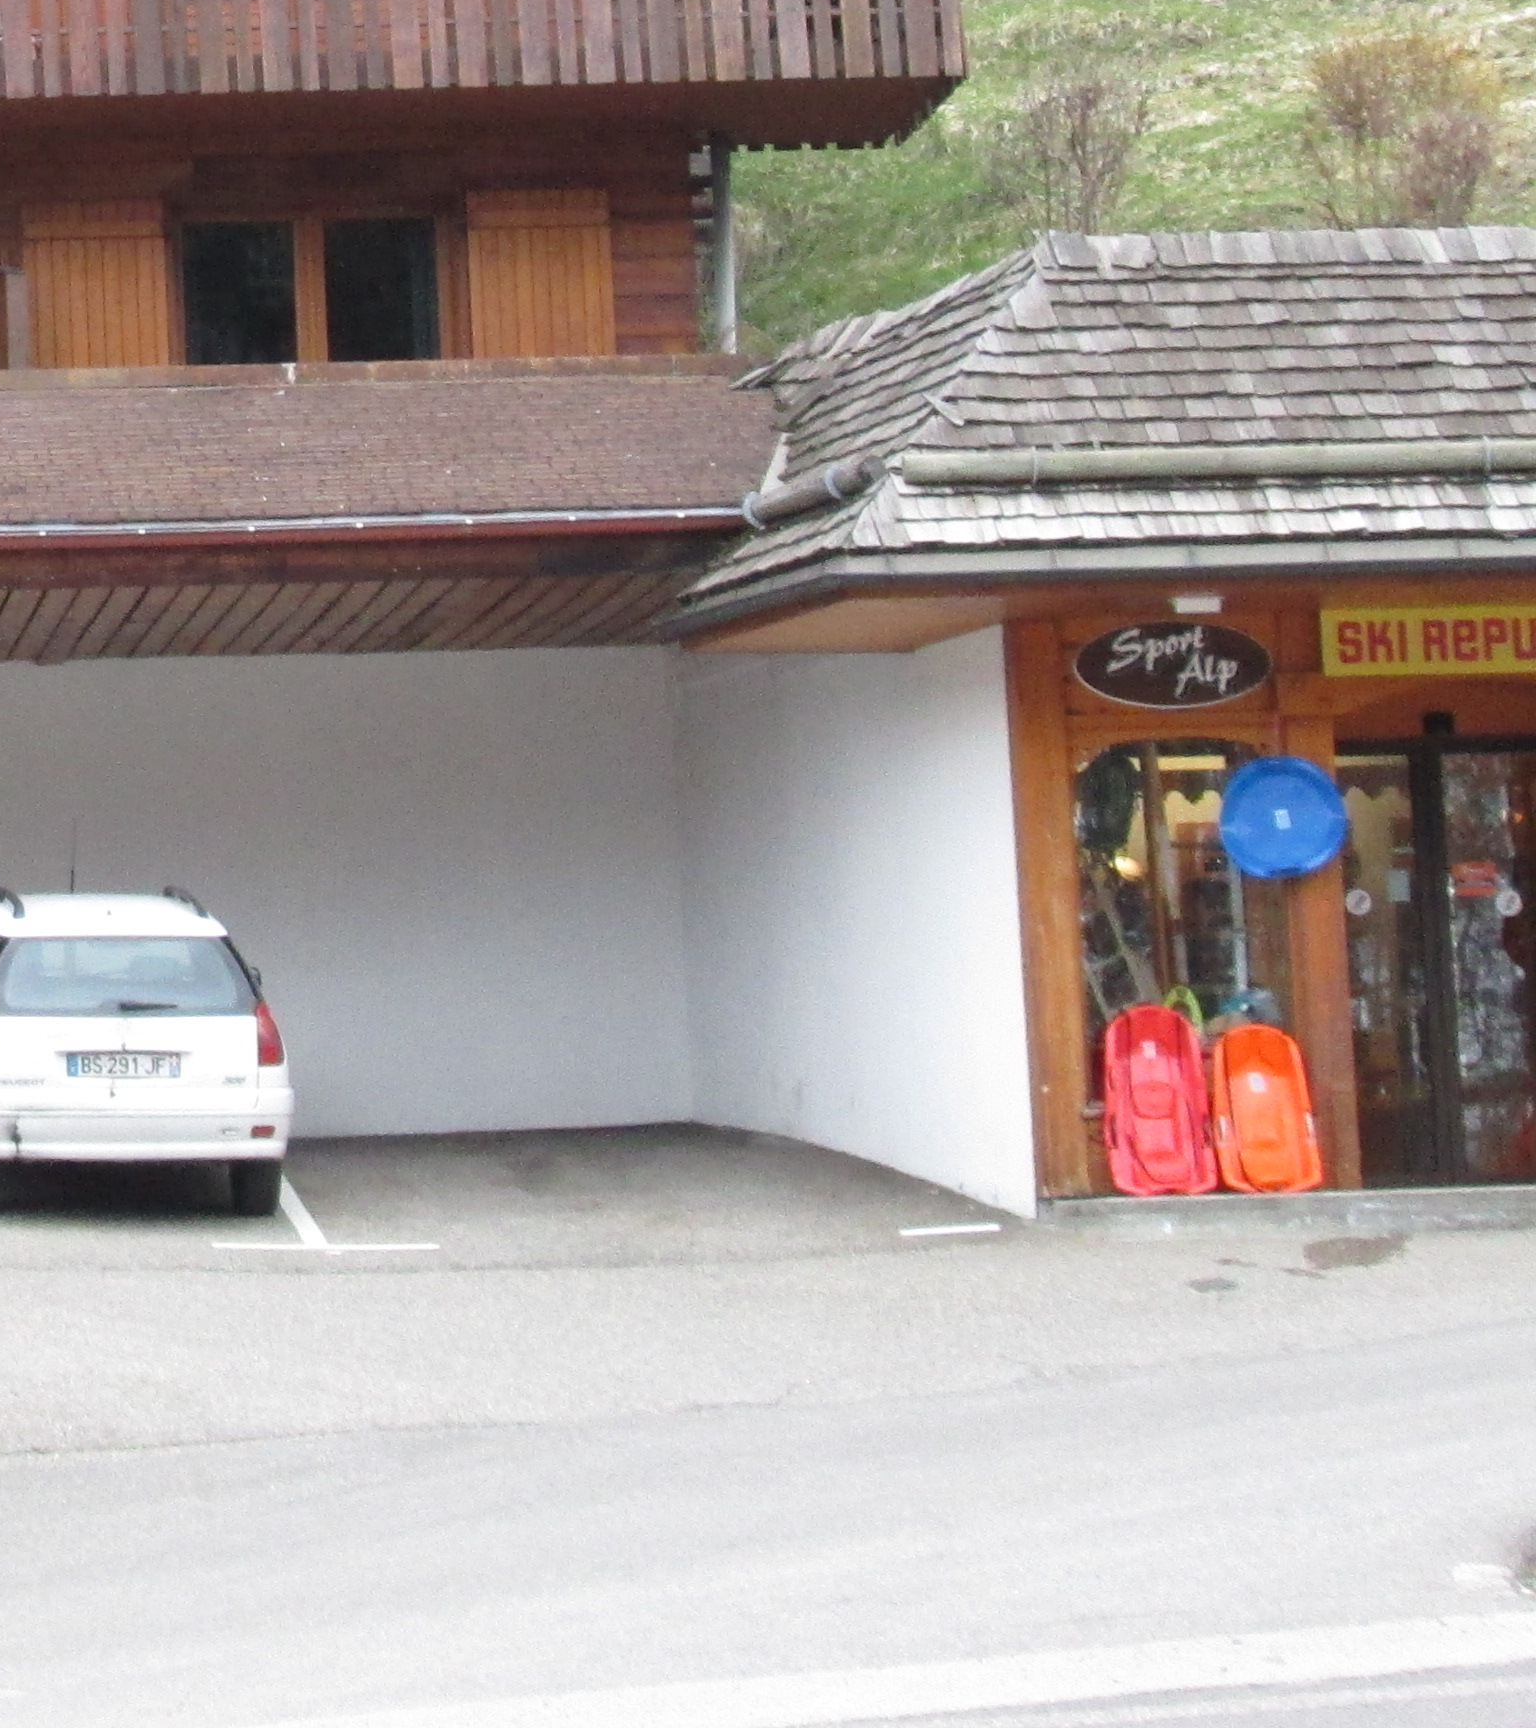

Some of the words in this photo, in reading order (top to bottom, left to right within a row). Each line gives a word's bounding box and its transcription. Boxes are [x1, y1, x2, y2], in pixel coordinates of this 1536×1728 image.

[1106, 625, 1205, 673] Sport
[1338, 620, 1407, 663] SKI
[1175, 650, 1238, 698] Alp
